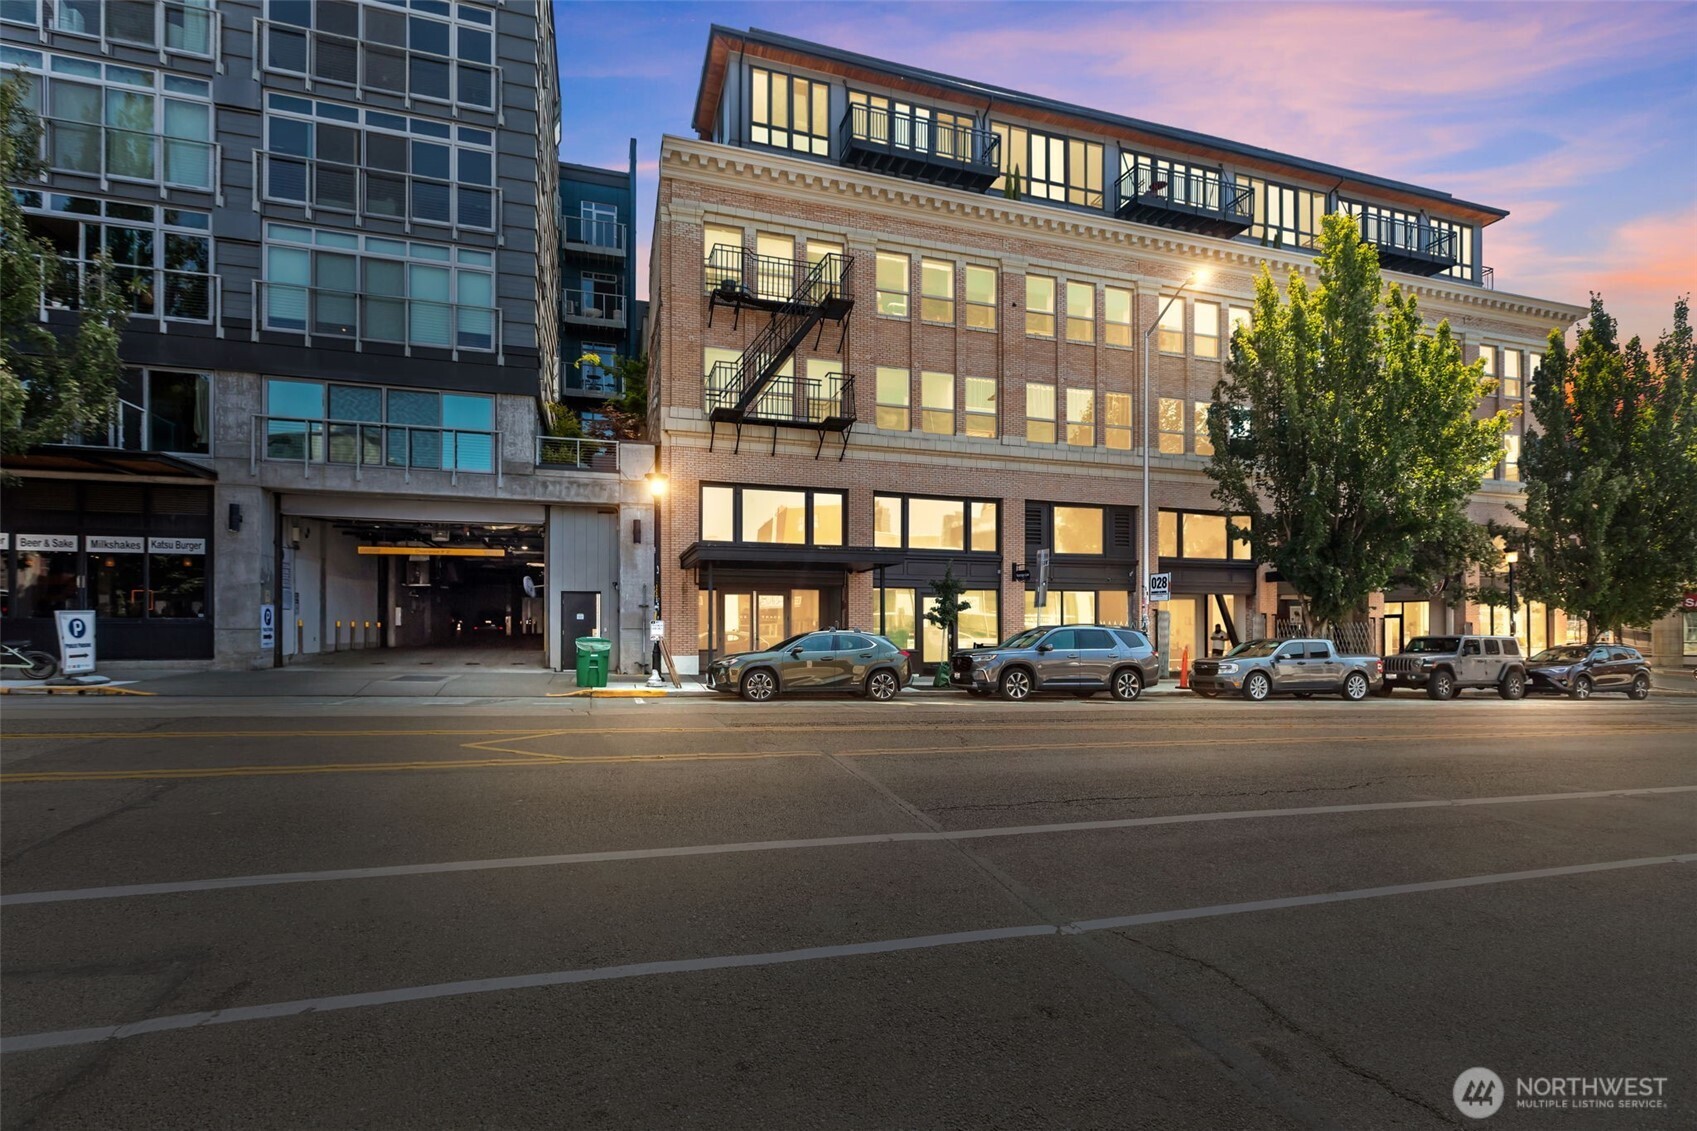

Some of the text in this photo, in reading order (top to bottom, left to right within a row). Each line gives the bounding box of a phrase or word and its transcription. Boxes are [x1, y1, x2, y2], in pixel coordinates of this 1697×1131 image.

[20, 538, 74, 548] Beer & Sake
[91, 540, 141, 549] Milkshakes
[151, 541, 203, 551] Katsu Burger
[1151, 576, 1168, 589] 028
[73, 620, 83, 637] P
